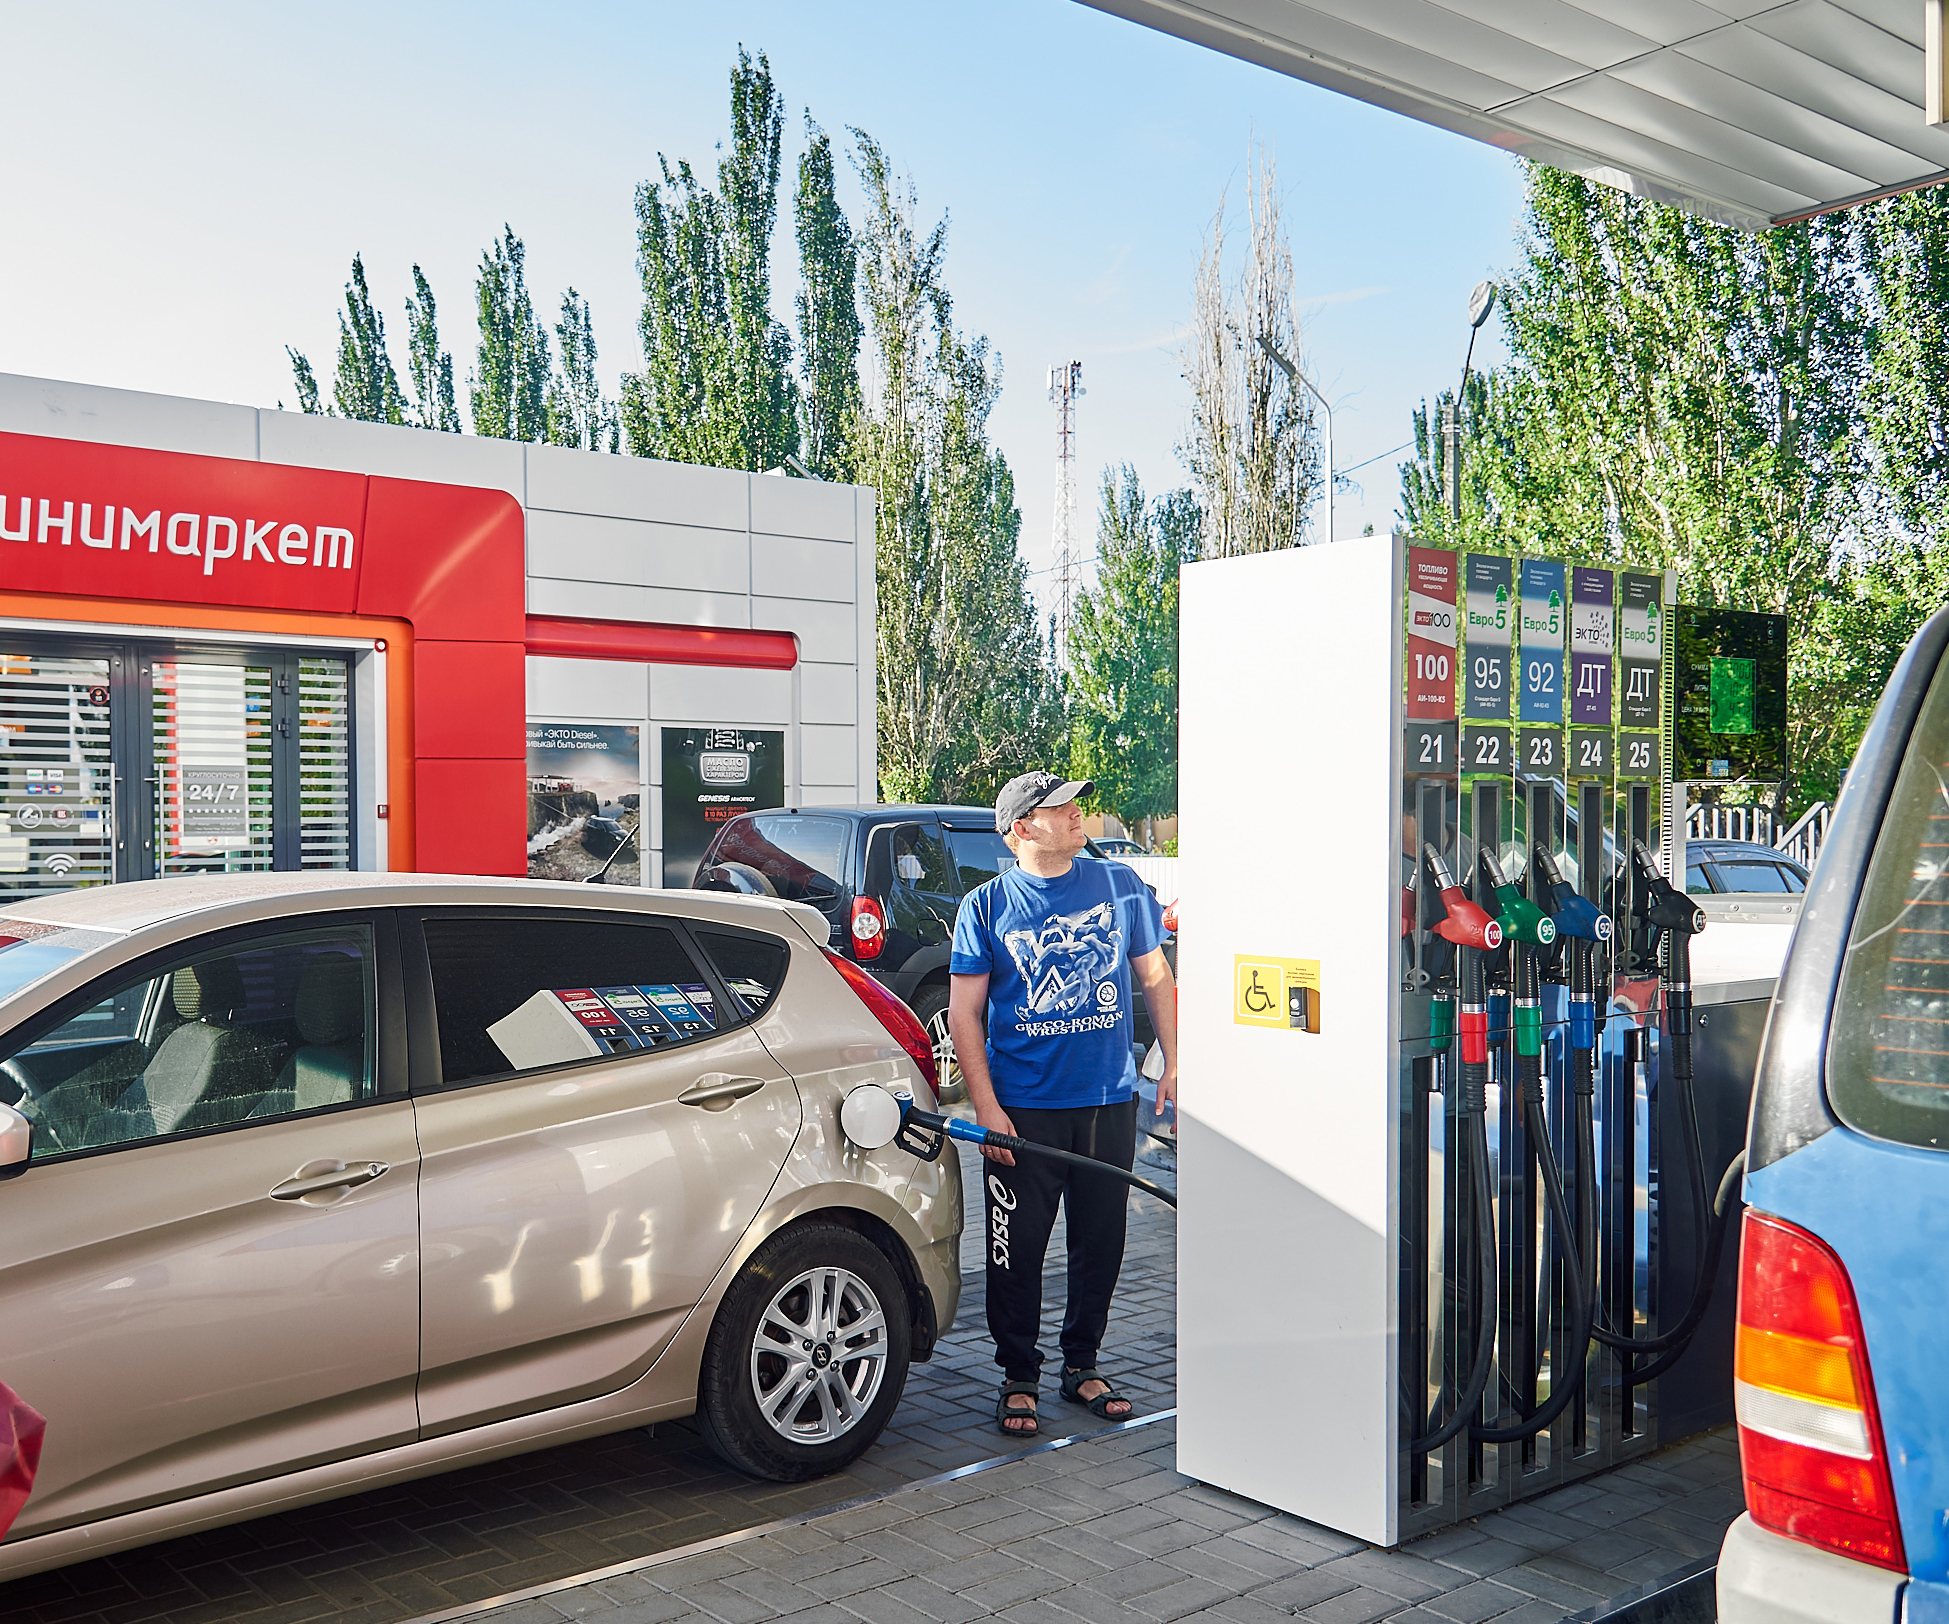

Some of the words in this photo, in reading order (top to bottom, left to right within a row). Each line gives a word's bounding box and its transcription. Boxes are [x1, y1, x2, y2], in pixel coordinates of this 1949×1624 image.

[1418, 564, 1448, 575] ТОПЛИВО
[1416, 615, 1430, 623] ЭКТО
[1429, 613, 1450, 628] 100
[1469, 612, 1494, 628] Евро
[1495, 609, 1507, 630] 5
[1523, 617, 1547, 633] Евро
[1548, 614, 1559, 635] 5
[1575, 627, 1600, 641] ЭКТО
[1624, 627, 1646, 642] Евро
[1646, 625, 1657, 644] 5
[1415, 654, 1448, 681] 100
[1474, 657, 1501, 690] 95
[1528, 662, 1554, 693] 92
[1576, 663, 1606, 698] ДТ
[1626, 668, 1655, 702] ДТ
[1417, 694, 1446, 703] АИ-100-К5
[557, 740, 575, 749] быть
[576, 742, 609, 750] сильнее.
[1420, 734, 1444, 763] 21
[1475, 736, 1500, 765] 22
[1529, 737, 1553, 765] 23
[1580, 740, 1603, 767] 24
[1628, 742, 1651, 768] 25
[707, 757, 744, 767] МАСЛО
[189, 783, 239, 804] 24/7
[1489, 930, 1500, 940] 100
[1542, 924, 1553, 937] 95
[1600, 922, 1610, 934] 92
[1015, 1011, 1124, 1032] GRECO-ROMAN
[1026, 1020, 1115, 1037] WRESTLING
